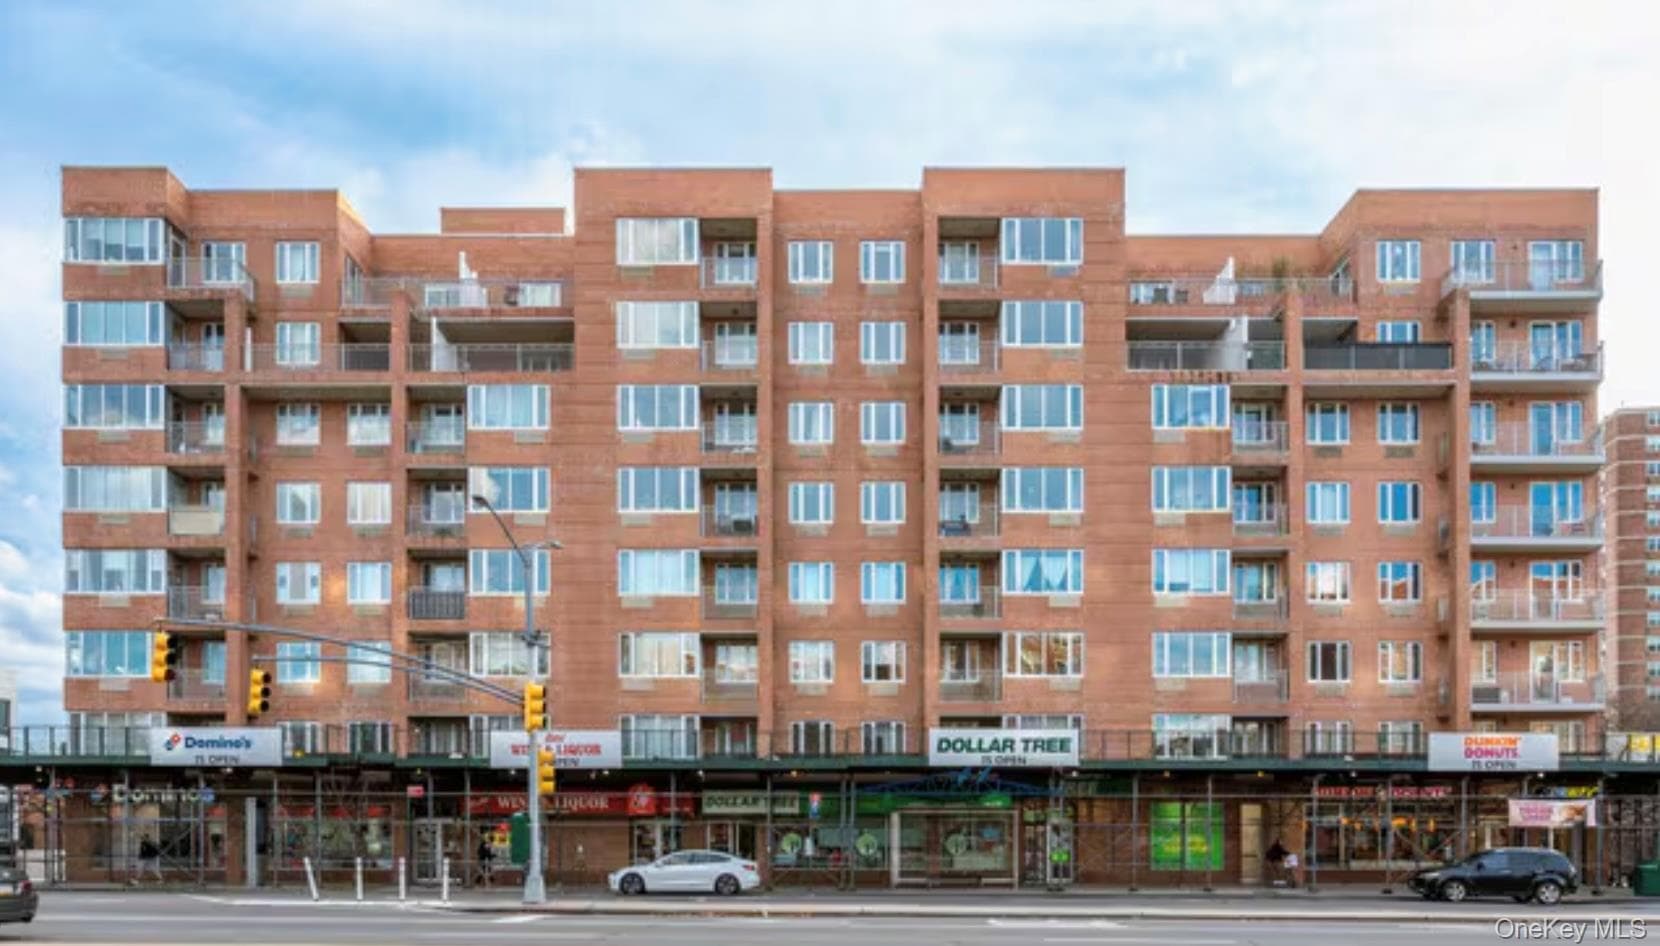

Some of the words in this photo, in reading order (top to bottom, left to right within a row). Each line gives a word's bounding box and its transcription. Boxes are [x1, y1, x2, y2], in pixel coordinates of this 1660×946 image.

[184, 735, 252, 749] Domino's
[937, 737, 1015, 753] DOLLAR
[1020, 737, 1072, 753] TREE
[208, 755, 240, 764] OPEN
[994, 756, 1027, 766] OPEN
[1485, 760, 1517, 769] OPEN
